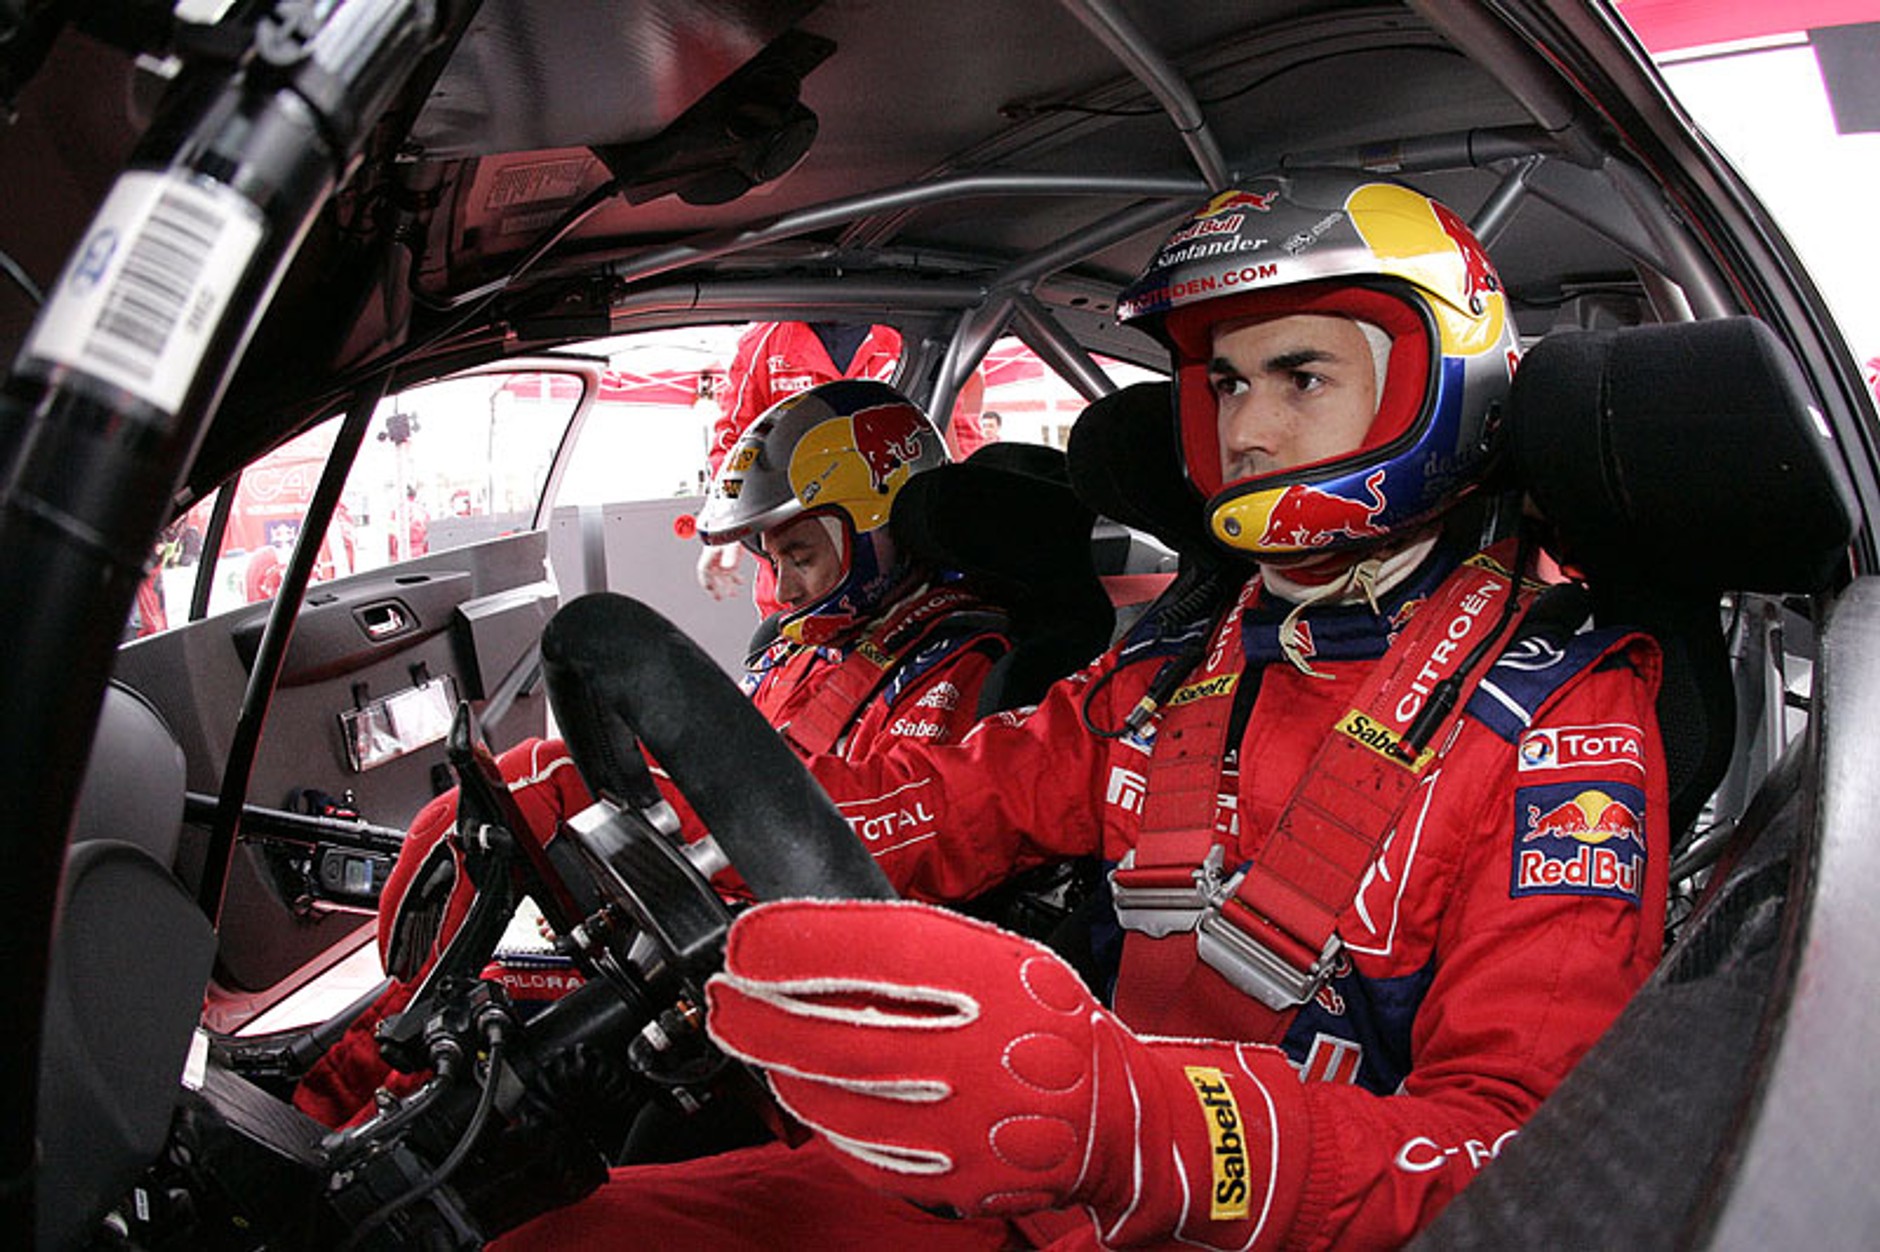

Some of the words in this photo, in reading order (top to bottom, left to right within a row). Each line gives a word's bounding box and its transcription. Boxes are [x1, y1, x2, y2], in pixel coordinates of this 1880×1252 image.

[1199, 214, 1245, 236] Bull
[1157, 234, 1268, 267] Santander
[1395, 579, 1503, 723] CITROËN
[1346, 716, 1400, 758] Sabe
[1561, 734, 1643, 758] TOTA
[843, 802, 935, 841] TOTAL
[1518, 845, 1591, 888] Red
[1199, 1080, 1247, 1204] Sabelt
